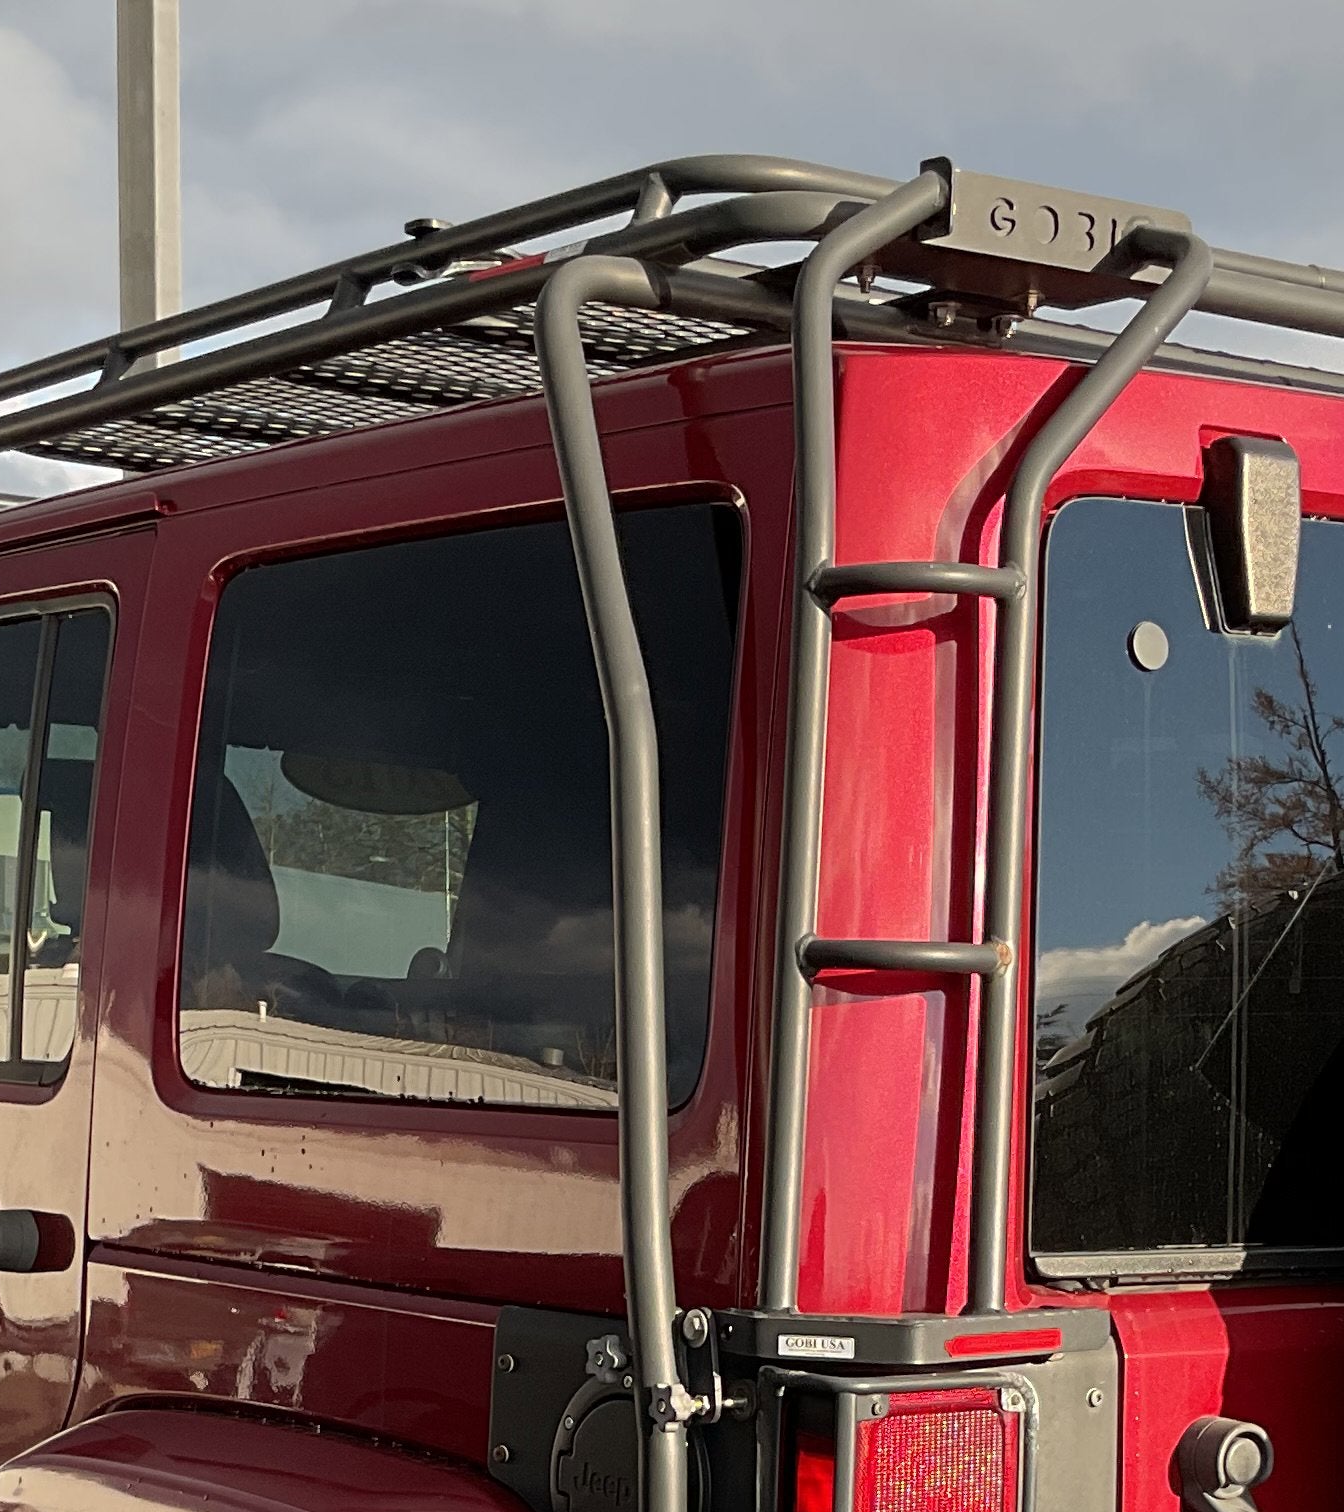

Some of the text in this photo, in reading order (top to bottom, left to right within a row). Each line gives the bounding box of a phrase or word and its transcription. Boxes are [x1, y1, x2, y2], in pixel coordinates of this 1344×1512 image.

[989, 196, 1118, 253] GOBI
[785, 1337, 845, 1350] GOBI USA
[573, 1462, 633, 1507] Jeep
